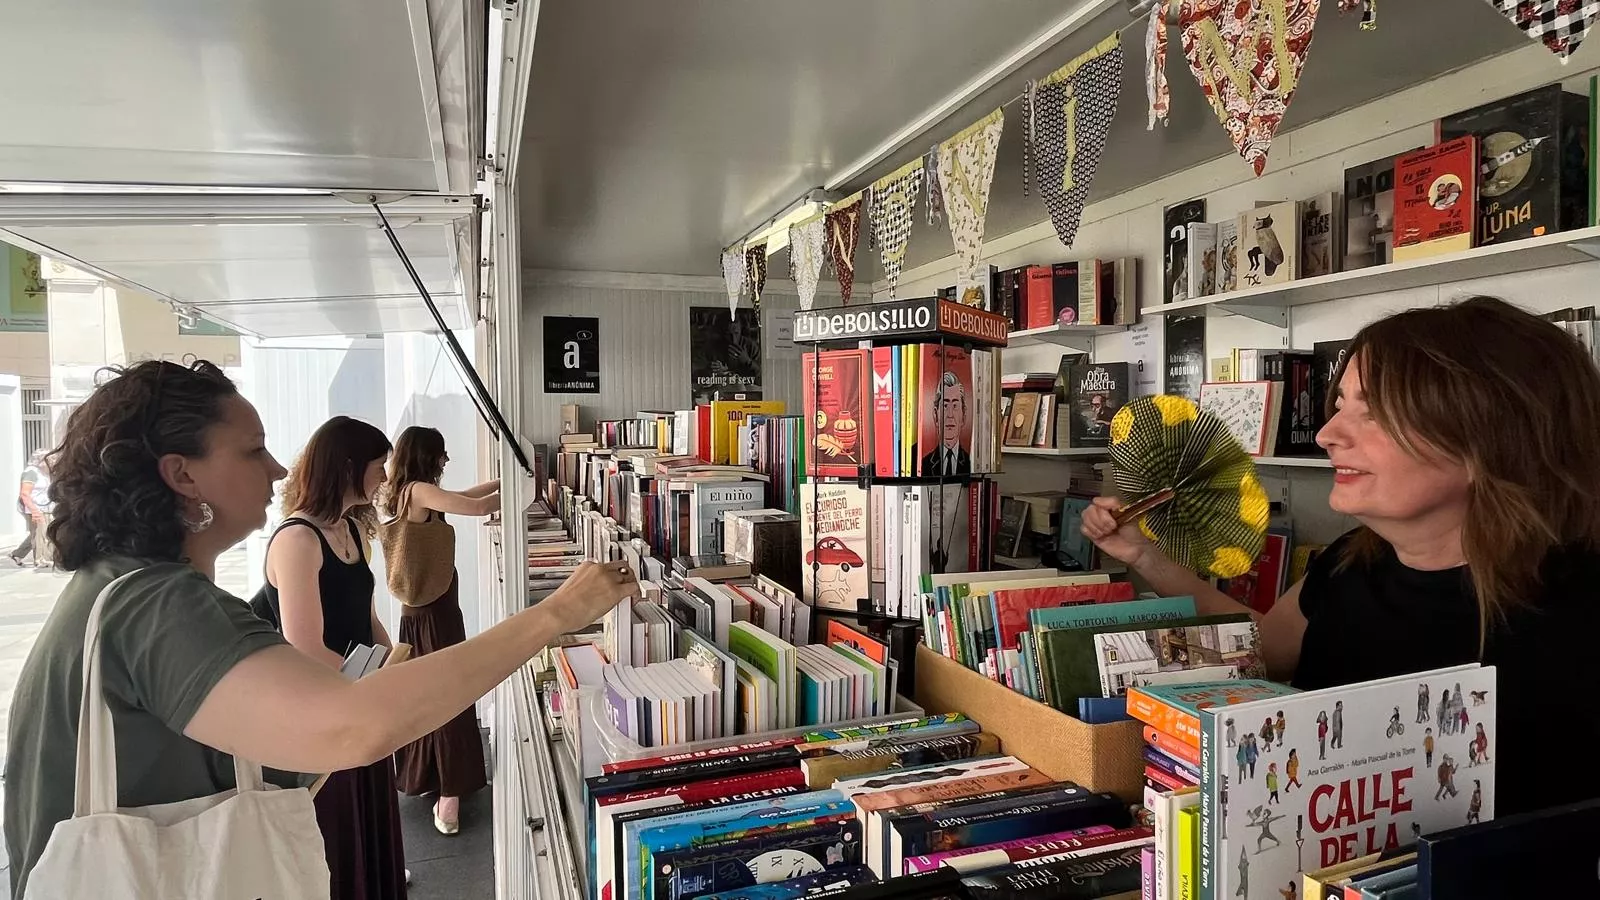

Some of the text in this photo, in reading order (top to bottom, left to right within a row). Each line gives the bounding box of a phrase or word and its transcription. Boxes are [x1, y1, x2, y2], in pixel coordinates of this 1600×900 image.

[1481, 200, 1532, 244] LUNA
[697, 373, 756, 387] reading is sexy
[873, 368, 892, 394] M
[1087, 370, 1109, 382] Obra
[1080, 379, 1116, 394] Maestra
[710, 489, 753, 501] El niño
[1047, 611, 1185, 630] LUCA TORTOLINI MARCO SOMA
[1202, 731, 1210, 746] Ana
[1202, 748, 1210, 785] Garralón
[1308, 768, 1320, 777] Ana
[1320, 763, 1345, 775] Garralón
[1367, 753, 1389, 764] Pascual
[1388, 750, 1396, 759] de
[1395, 750, 1402, 758] la
[1401, 748, 1416, 757] Torre
[1308, 766, 1414, 834] CALLE
[1202, 814, 1210, 848] Pascual
[1022, 837, 1083, 854] REDES
[1202, 849, 1209, 858] de
[1320, 822, 1400, 869] DE LA
[1202, 858, 1210, 866] la
[1202, 866, 1210, 889] Torre
